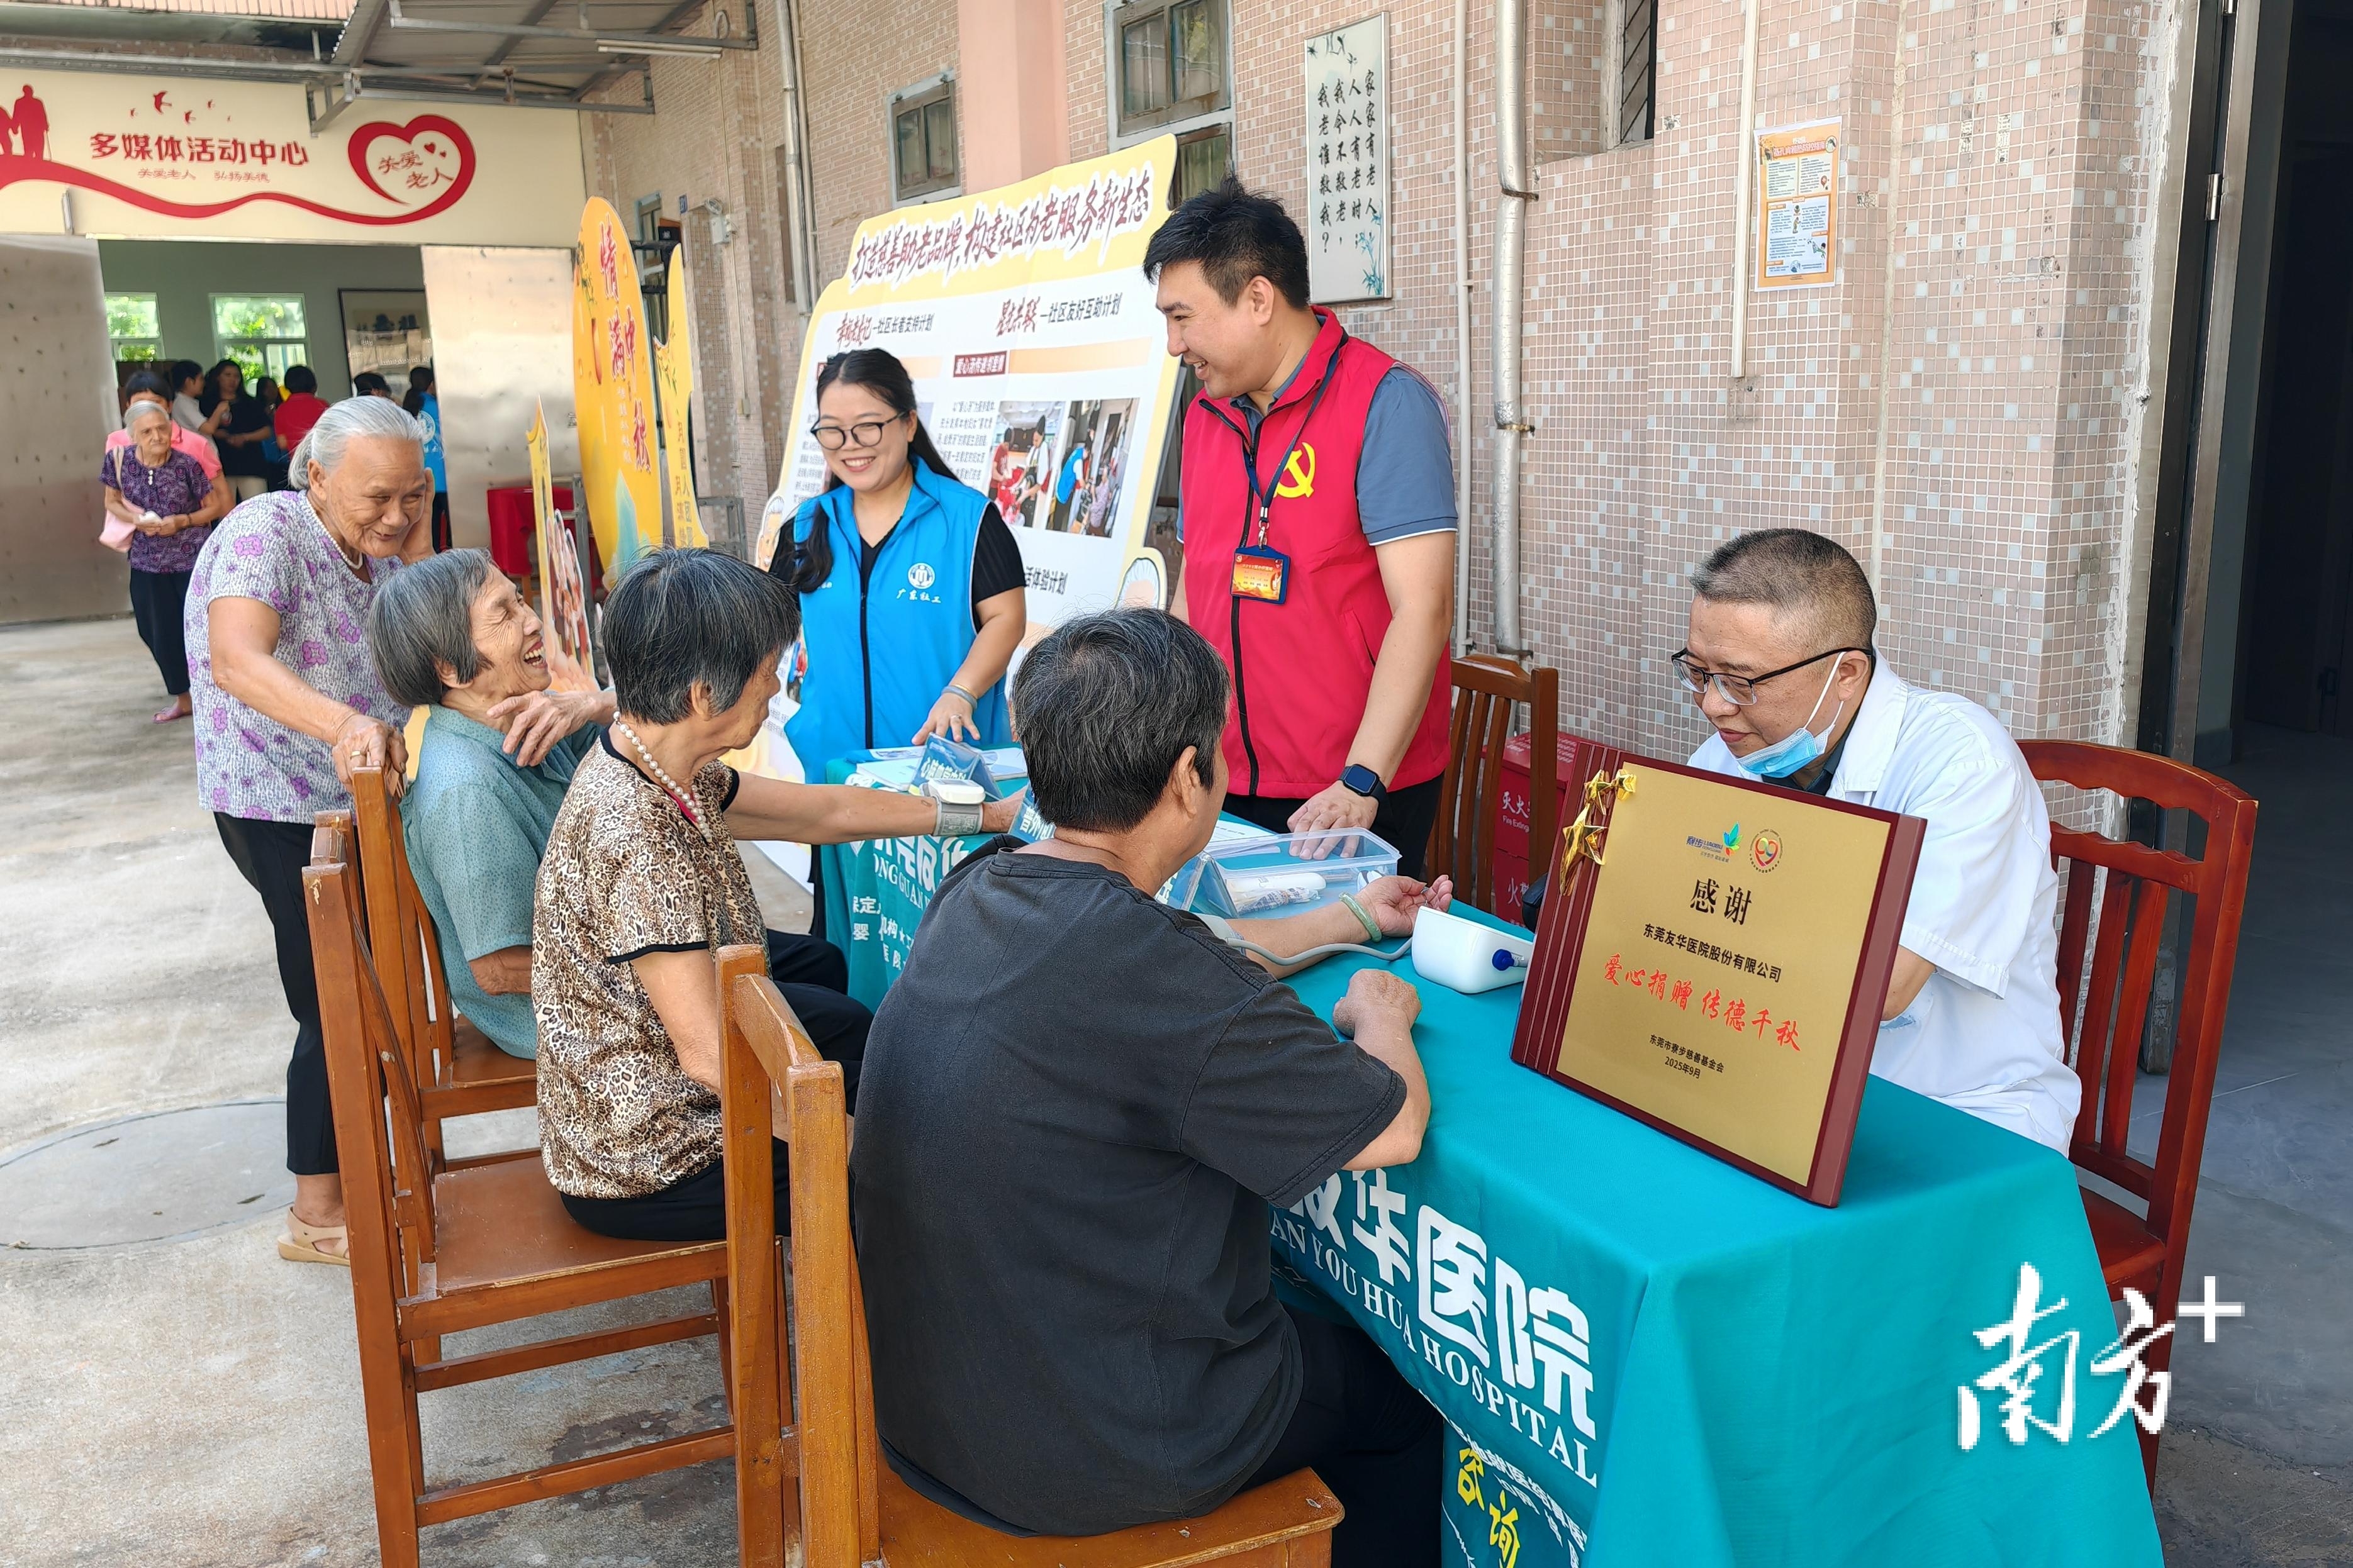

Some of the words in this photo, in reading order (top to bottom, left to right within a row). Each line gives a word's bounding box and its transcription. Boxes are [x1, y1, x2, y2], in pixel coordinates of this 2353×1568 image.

[90, 133, 310, 166] 多媒体活动中心
[378, 150, 424, 174] 关爱
[138, 168, 196, 181] 关爱老人
[406, 167, 454, 189] 老人
[896, 588, 942, 604] 广东社工
[1502, 791, 1531, 819] 灭火
[1690, 879, 1752, 925] 感谢
[1643, 923, 1782, 983] 东莞友华医院股份有限公司
[1604, 953, 1693, 1011] 爱心捐赠
[1701, 987, 1801, 1052] 传德千秋
[1650, 1034, 1724, 1074] 东莞市寮步慈善基金会
[1665, 1056, 1701, 1079] 2025年9月
[1311, 1232, 1357, 1296] YOU
[1361, 1276, 1415, 1354] HUA
[1420, 1330, 1597, 1488] HOSPITAL
